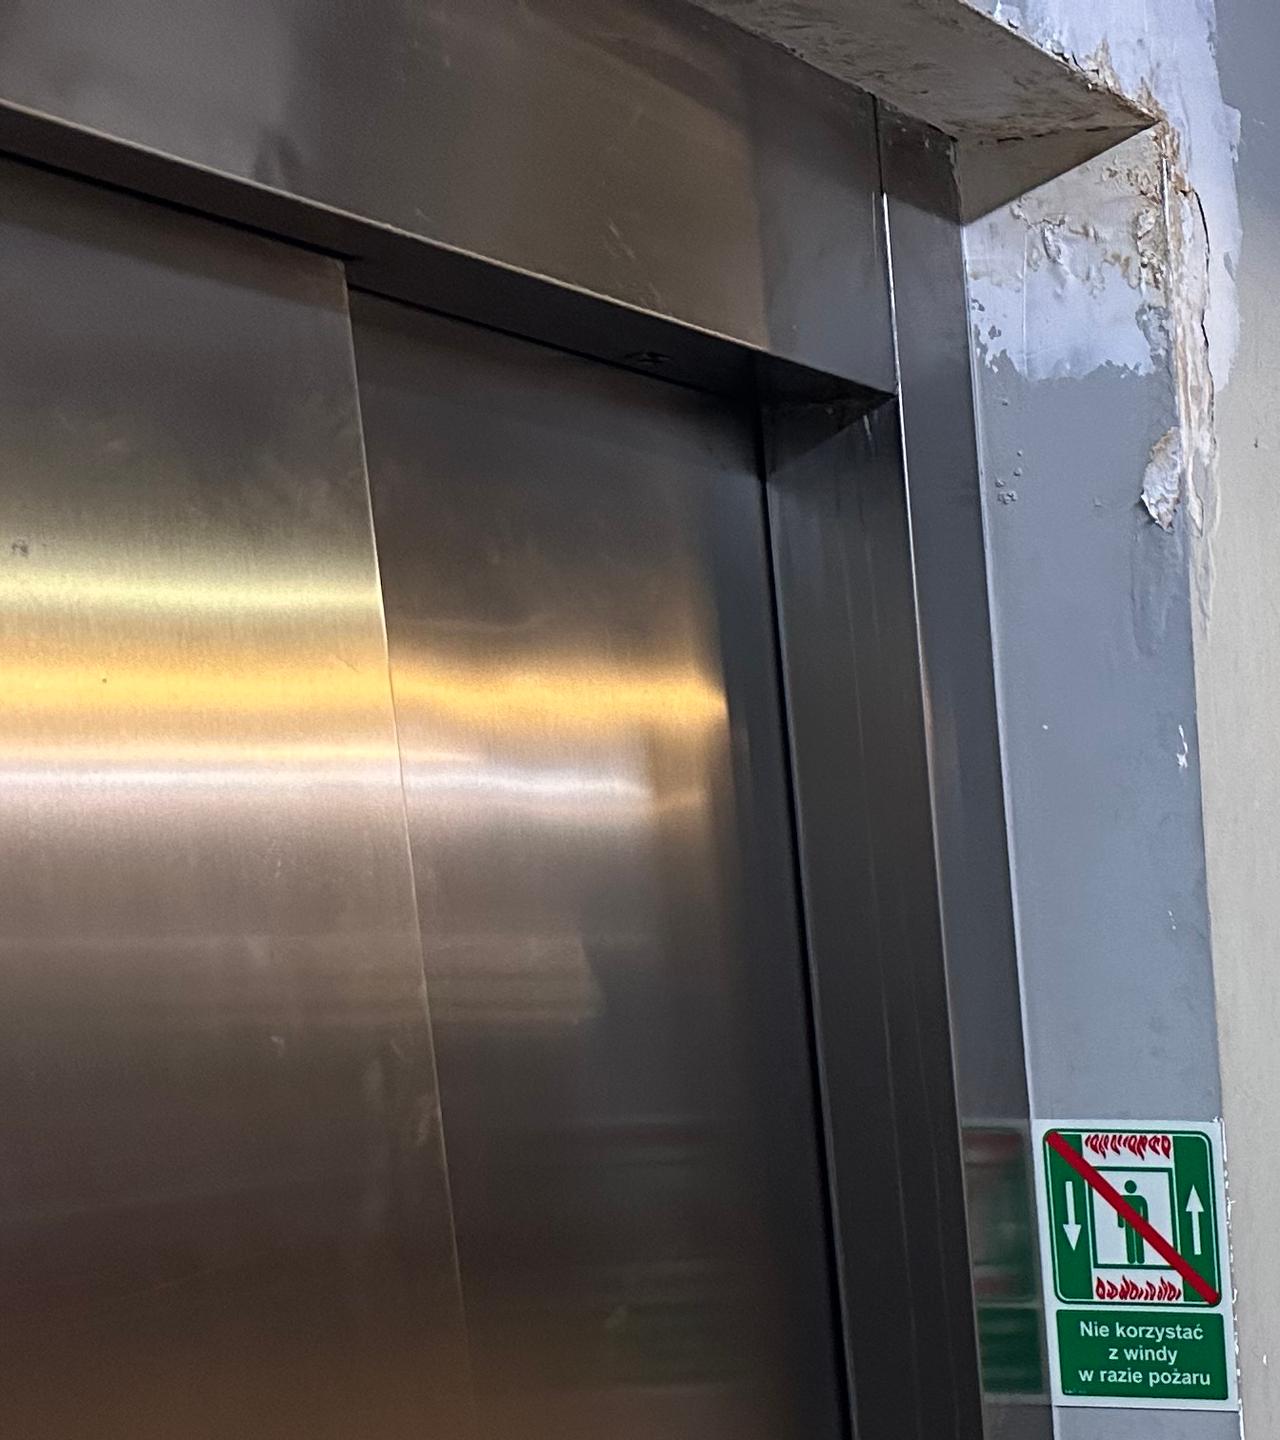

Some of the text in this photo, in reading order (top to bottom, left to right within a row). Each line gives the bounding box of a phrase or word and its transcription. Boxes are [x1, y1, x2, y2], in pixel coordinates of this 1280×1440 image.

[1079, 1320, 1204, 1343] Nie korzystać
[1108, 1345, 1178, 1366] z windy
[1078, 1367, 1211, 1388] w razie pożaru
